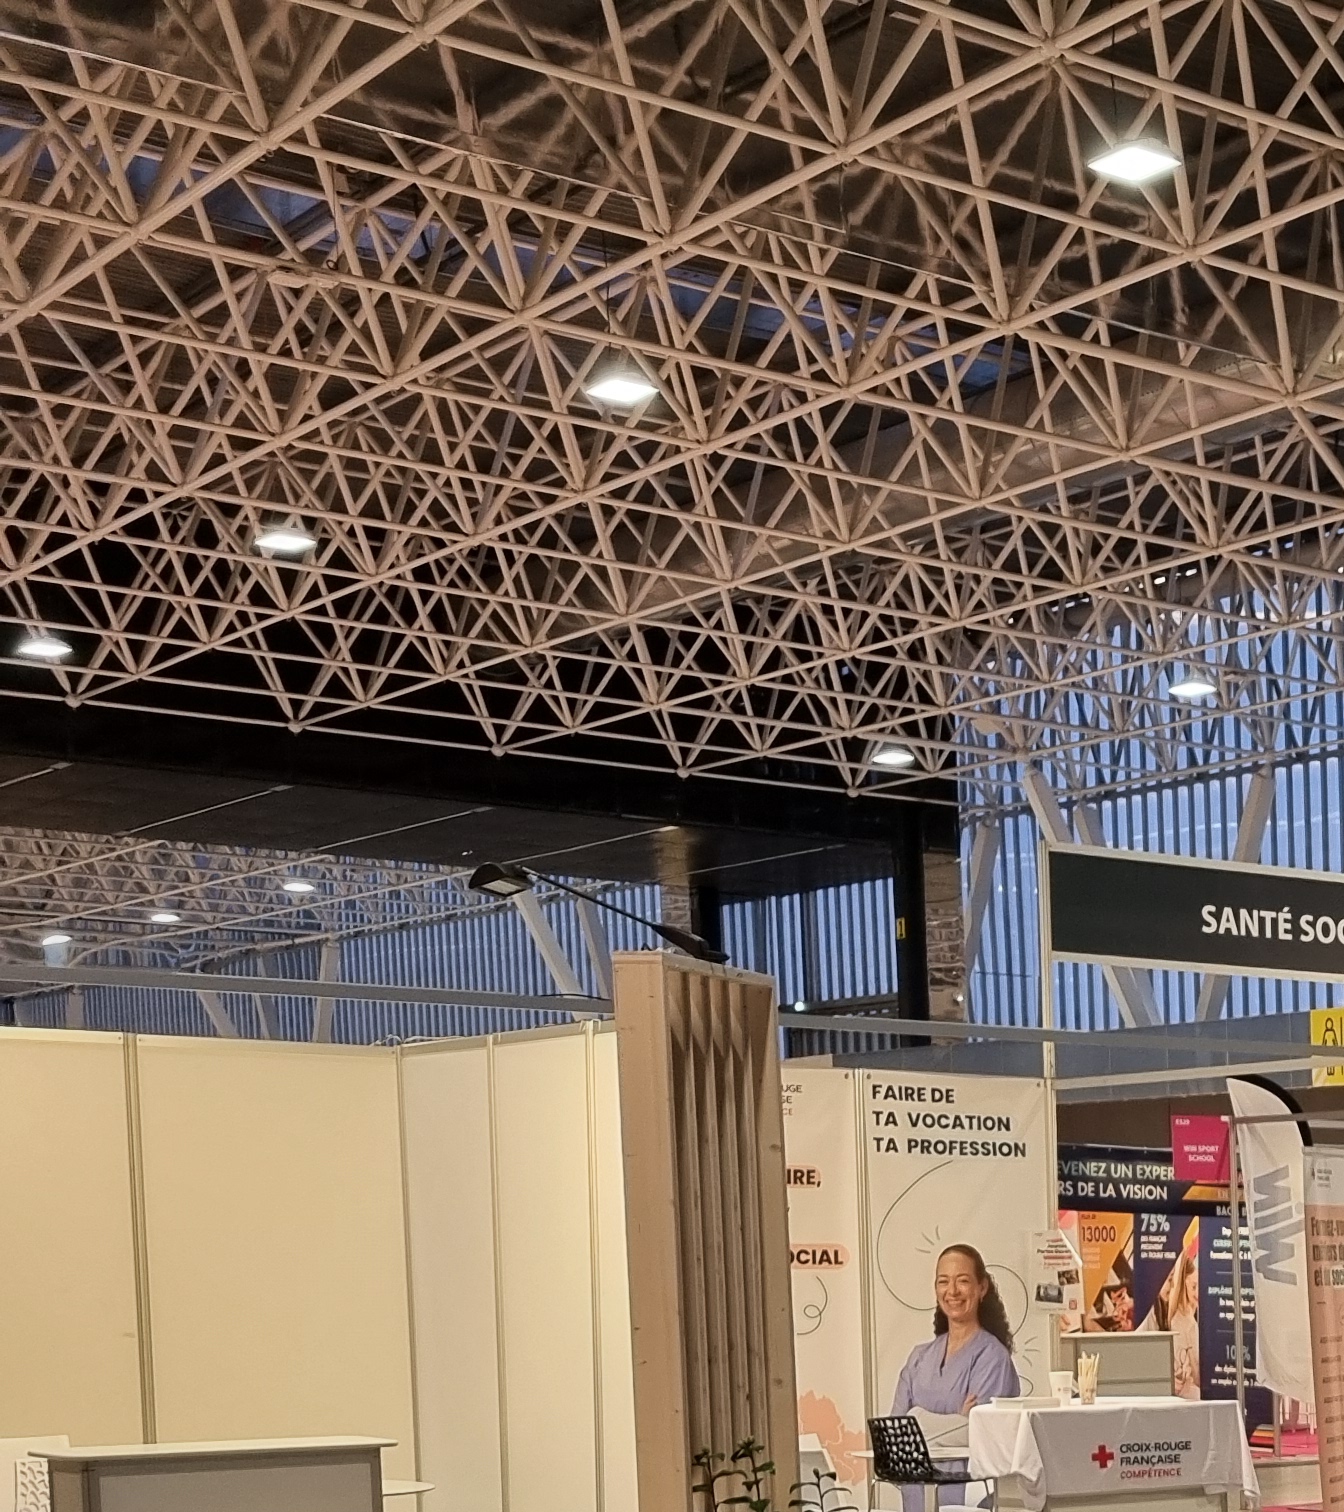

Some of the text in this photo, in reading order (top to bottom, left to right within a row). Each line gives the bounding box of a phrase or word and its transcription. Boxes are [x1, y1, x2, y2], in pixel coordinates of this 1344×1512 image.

[1201, 905, 1293, 940] SANTÉ
[872, 1084, 954, 1104] FAIRE DE
[872, 1111, 1011, 1132] TA VOCATION
[873, 1137, 1027, 1158] TA PROFESSION
[1110, 1164, 1132, 1179] UN
[1136, 1166, 1174, 1181] EXPER
[1078, 1182, 1095, 1197] DE
[1100, 1183, 1116, 1198] LA
[1120, 1184, 1167, 1200] VISION
[1141, 1213, 1170, 1232] 75%
[1082, 1225, 1116, 1242] 13000
[1120, 1441, 1191, 1453] CROIX-ROUGE
[1120, 1454, 1181, 1467] FRANÇAISE
[1121, 1468, 1181, 1479] COMPÉTENCE
